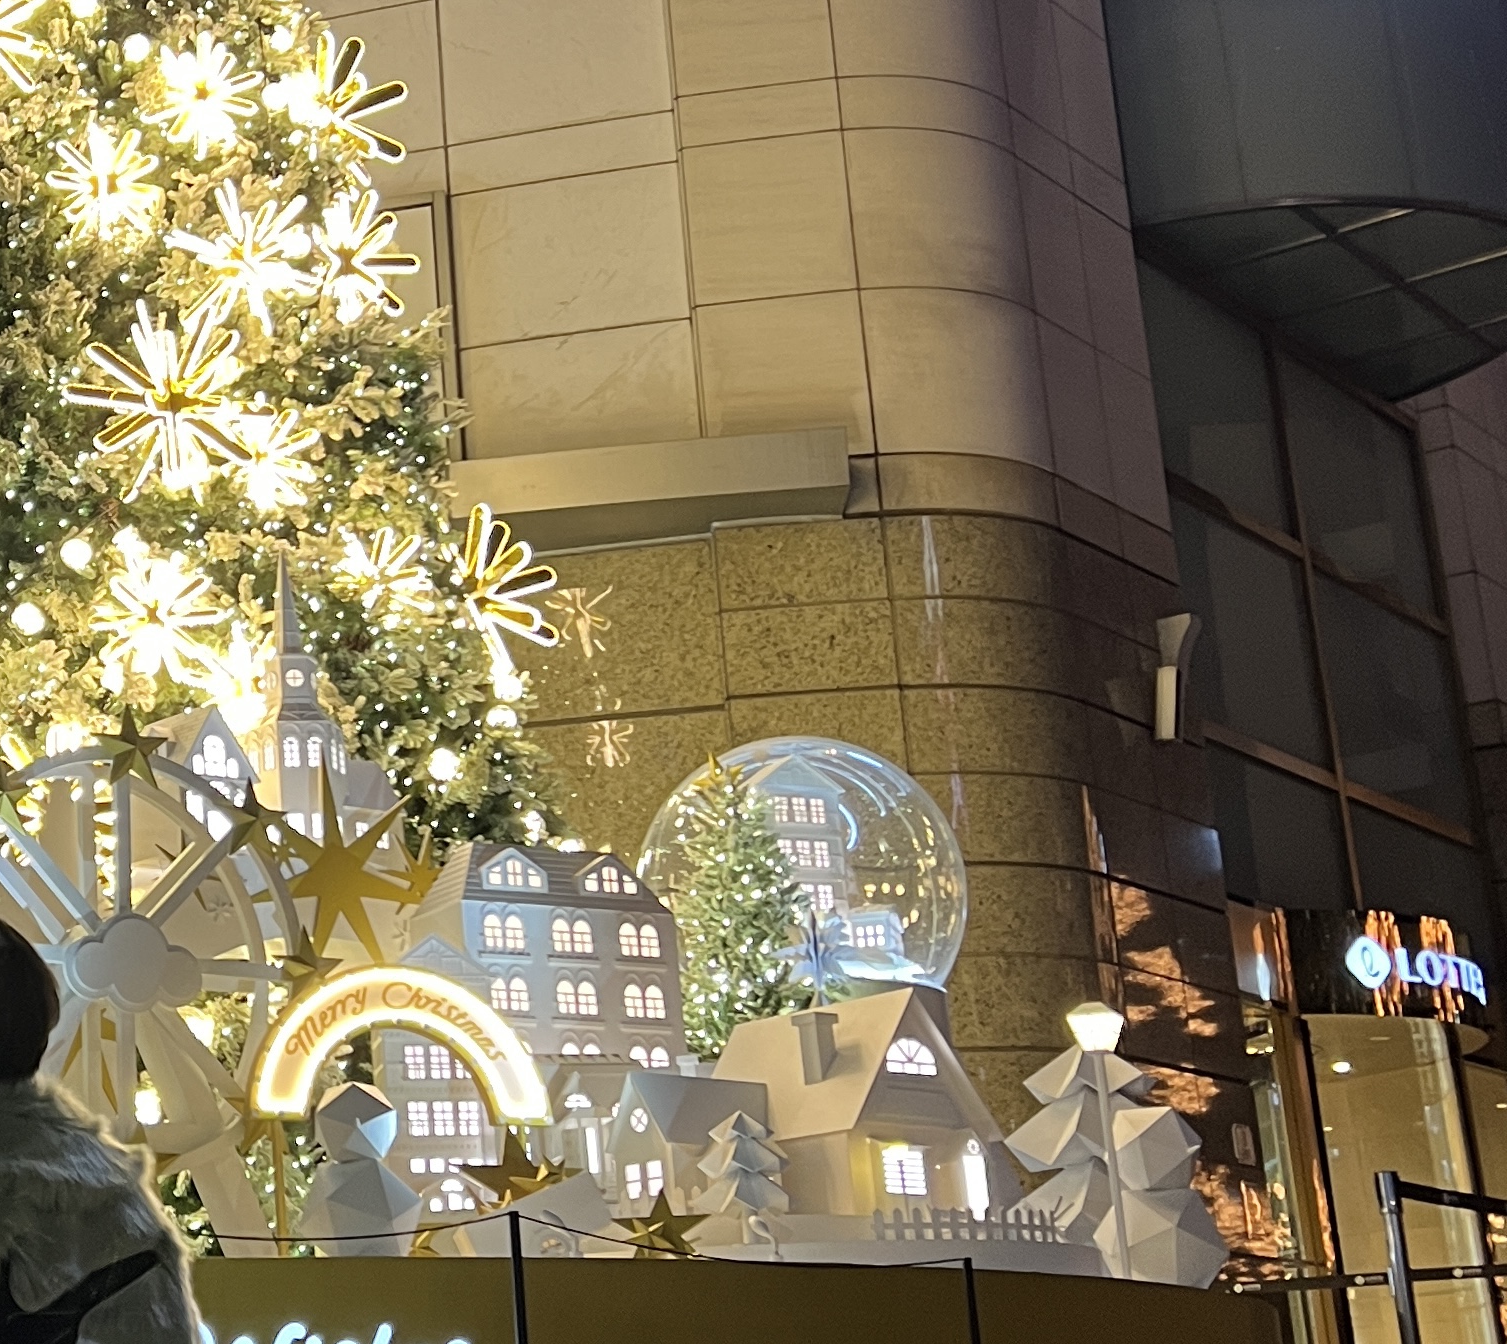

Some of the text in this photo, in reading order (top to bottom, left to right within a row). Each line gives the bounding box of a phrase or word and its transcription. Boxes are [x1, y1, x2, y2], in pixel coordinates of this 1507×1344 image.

[1394, 946, 1487, 1007] LOTTE
[284, 981, 508, 1062] Merry Christmas
